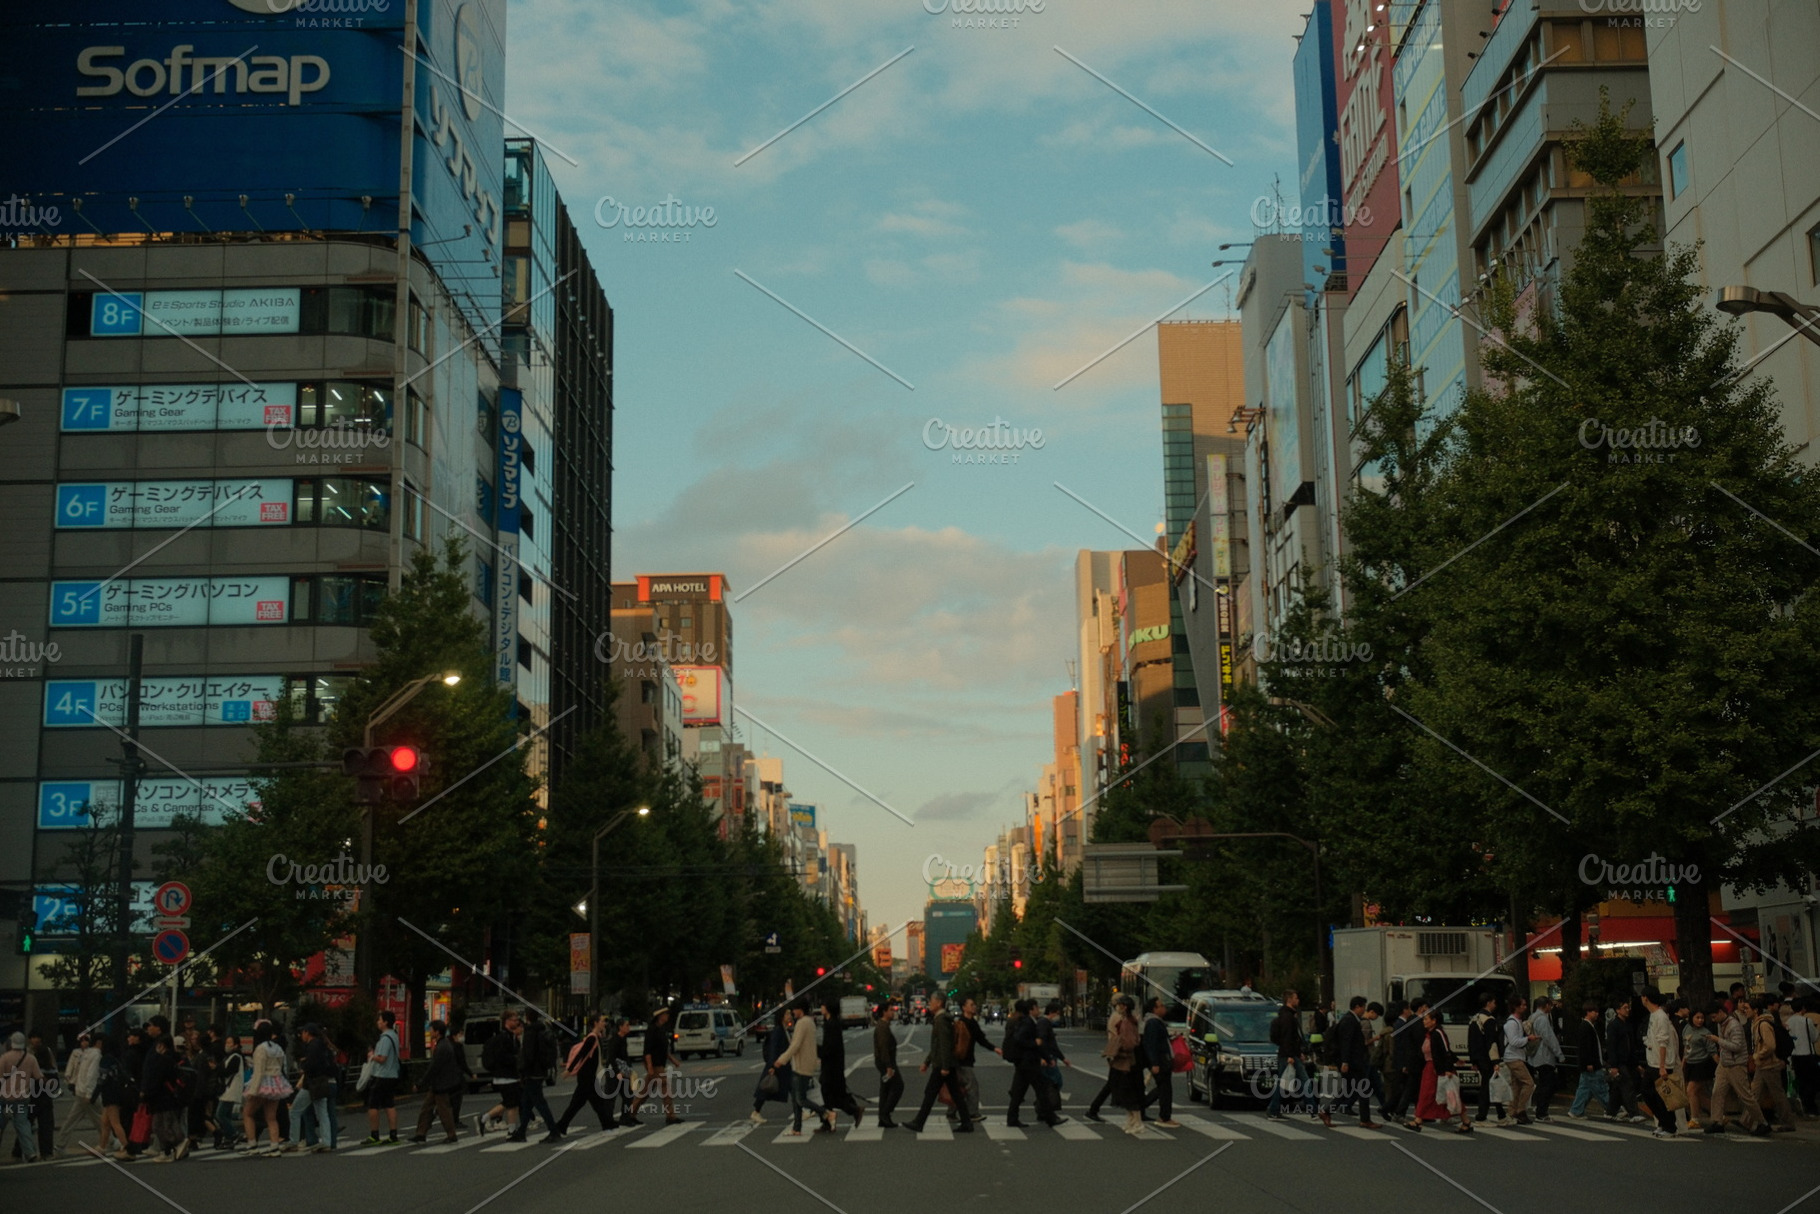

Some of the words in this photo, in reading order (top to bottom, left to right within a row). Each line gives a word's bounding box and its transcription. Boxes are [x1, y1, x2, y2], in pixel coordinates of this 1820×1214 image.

[76, 44, 330, 105] Sofmap
[208, 299, 245, 309] Studio
[250, 297, 295, 308] AKIBA
[102, 303, 134, 326] 8F
[116, 389, 268, 406] ゲーミングデバイス
[72, 398, 104, 421] 7F
[114, 407, 155, 419] Gaming
[159, 407, 186, 417] Gear
[268, 407, 287, 415] TAX
[503, 435, 518, 509] ソフマップ
[111, 484, 264, 502] ゲーミングデバイス
[66, 494, 99, 518] 6F
[109, 504, 150, 515] Gaming
[154, 504, 181, 514] Gear
[264, 504, 282, 512] TAX
[261, 512, 286, 521] FREE
[106, 583, 259, 600] ゲーミングパソコン
[652, 583, 672, 593] APA
[673, 582, 707, 592] HOTEL
[60, 592, 93, 616] 5F
[104, 602, 146, 614] Gaming
[150, 602, 173, 612] PCs
[261, 602, 279, 611] TAX
[258, 611, 283, 620] FREE
[54, 691, 88, 716] 4F
[99, 702, 123, 712] PCs
[140, 701, 219, 711] Workstations
[50, 792, 83, 817] 3F
[133, 803, 147, 813] Cs
[151, 803, 159, 812] &
[163, 802, 215, 813] Cameras
